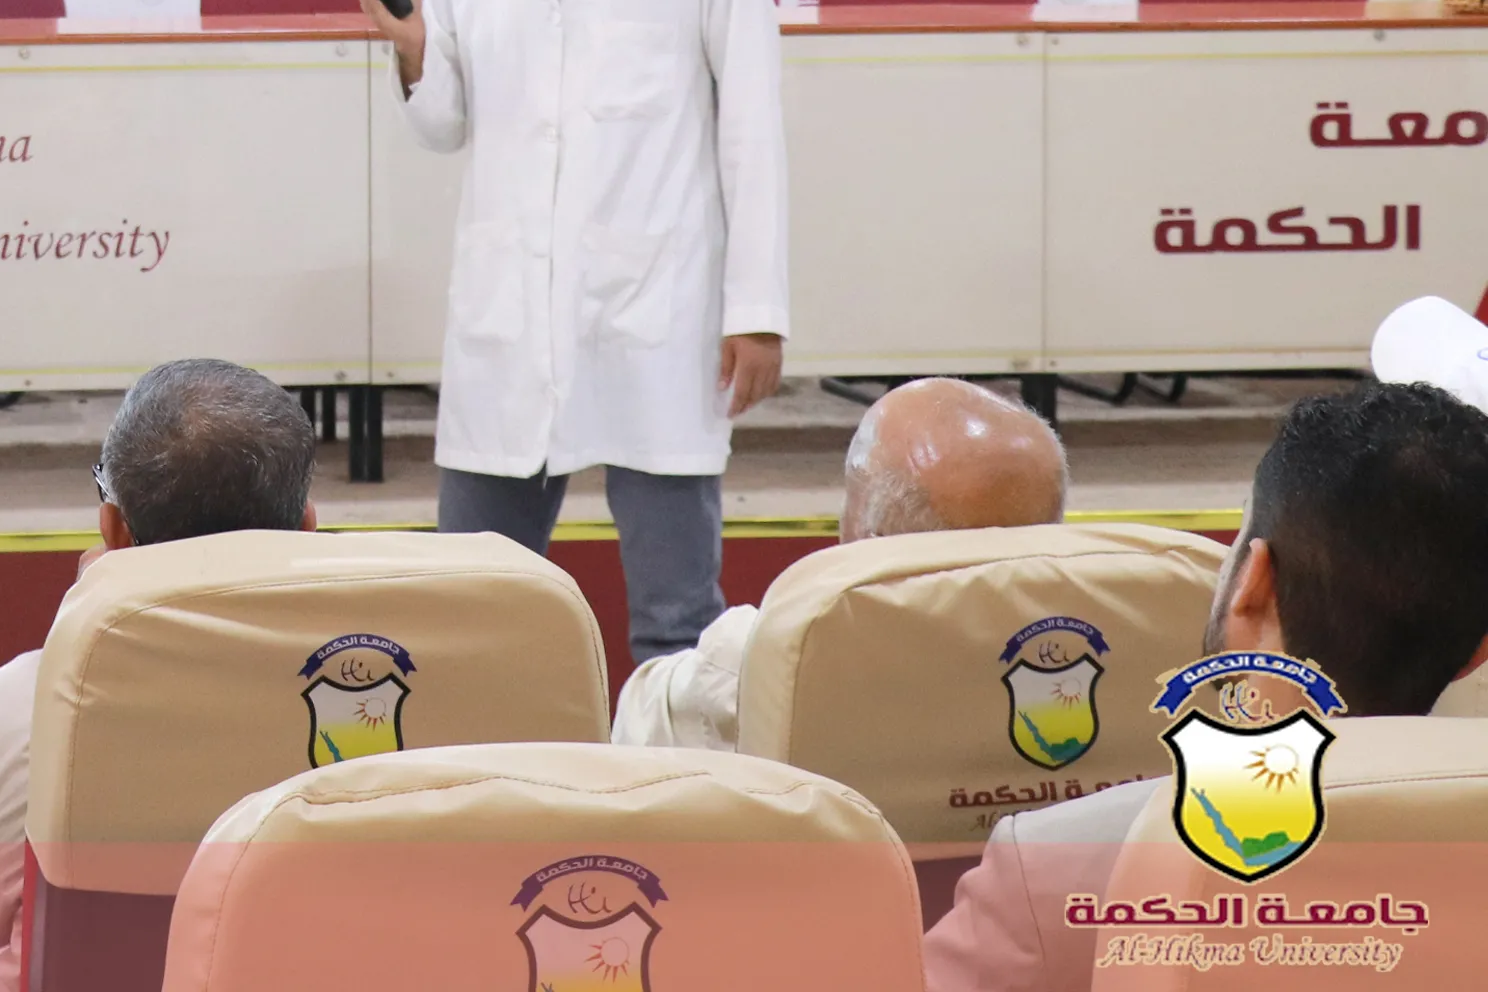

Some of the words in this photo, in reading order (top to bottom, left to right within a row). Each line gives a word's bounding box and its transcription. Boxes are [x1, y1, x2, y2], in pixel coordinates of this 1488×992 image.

[1153, 204, 1421, 255] الحكمة
[948, 781, 1058, 808] الحكمة
[536, 858, 593, 883] الحكمة
[596, 858, 648, 881] جامعة
